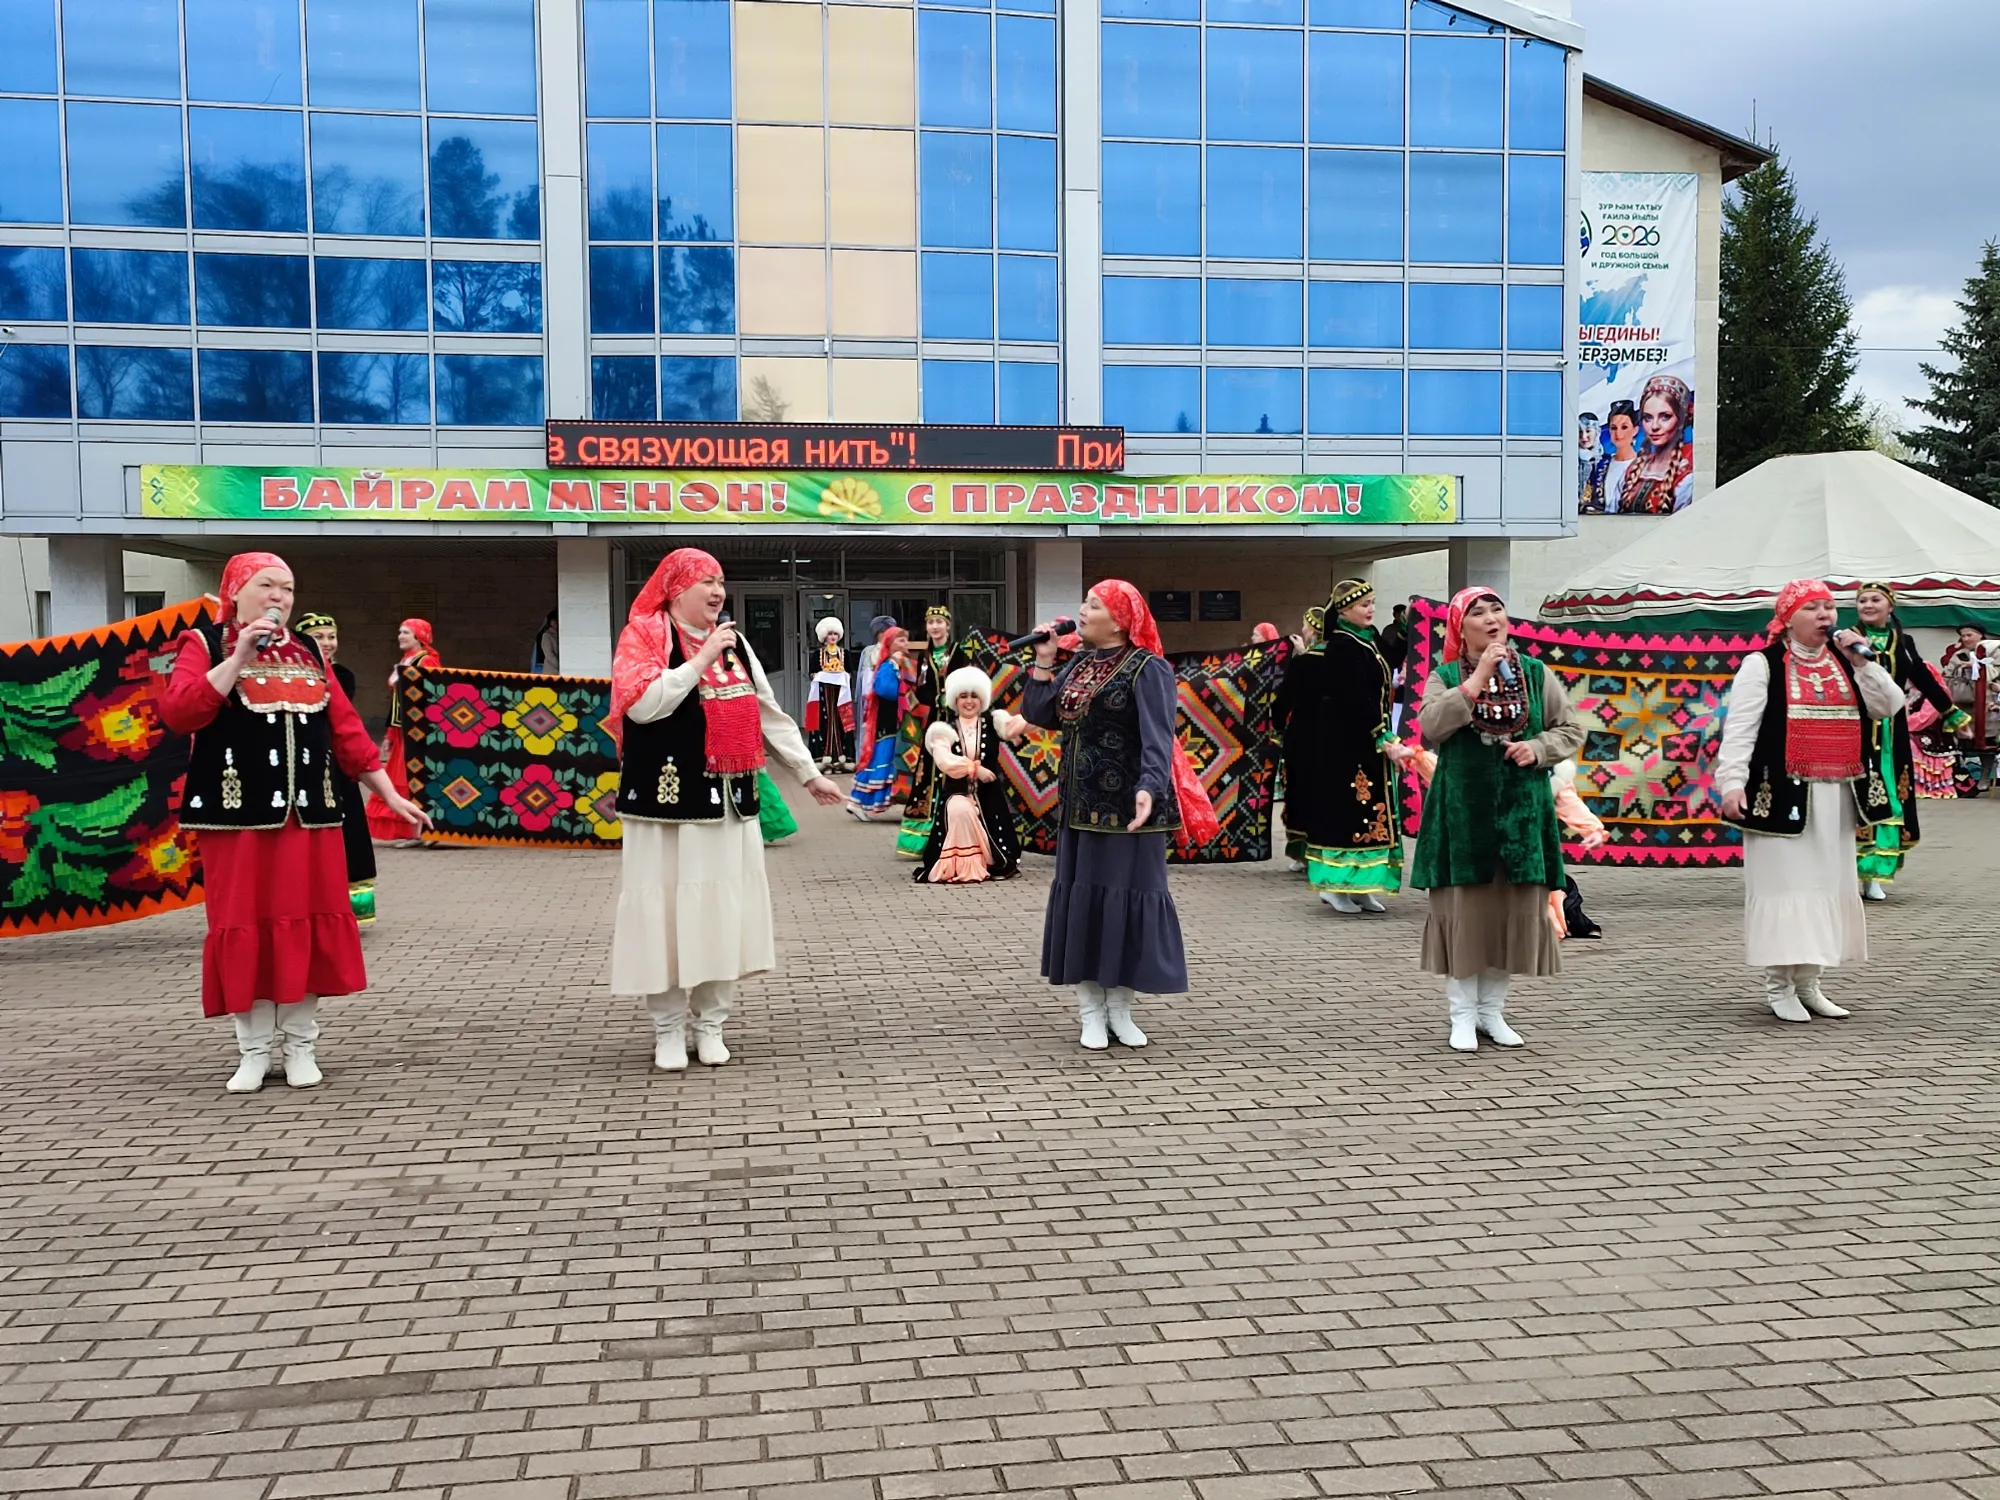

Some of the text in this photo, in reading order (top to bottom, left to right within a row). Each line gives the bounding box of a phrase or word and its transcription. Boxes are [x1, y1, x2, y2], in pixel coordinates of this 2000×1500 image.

[1632, 213, 1659, 221] ЙЫЛЫ
[1601, 225, 1660, 246] 2026
[1601, 251, 1659, 260] ГОД БОЛЬШОЙ
[1599, 261, 1640, 269] ДРУЖНОЙ
[1642, 262, 1669, 270] СЕМЬИ
[1596, 327, 1660, 343] ЕДИНЫ!
[1579, 347, 1668, 365] ЕРҘӘМБЕҘ!
[578, 436, 789, 466] связующая
[805, 432, 916, 465] нить"!
[1058, 434, 1123, 469] При
[261, 470, 1363, 520] БАЙРАМ МЕНӘН! С ПРАЗДНИКОМ!
